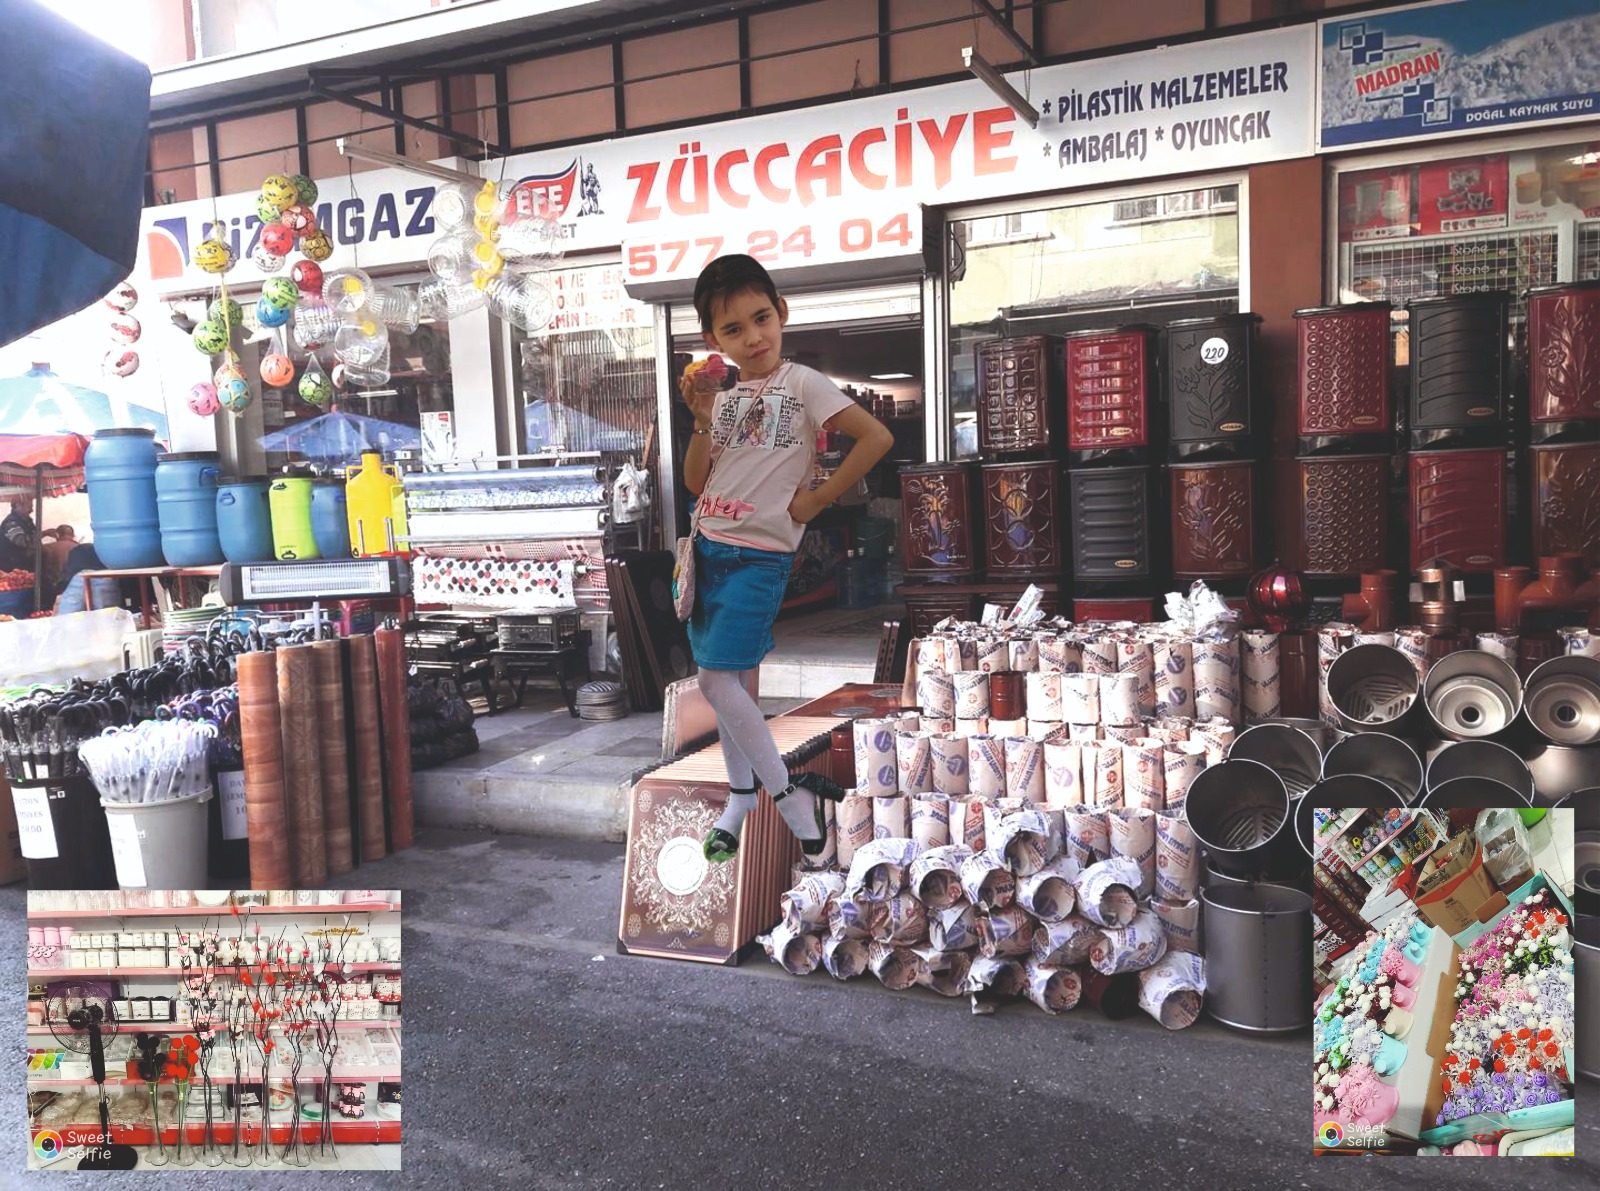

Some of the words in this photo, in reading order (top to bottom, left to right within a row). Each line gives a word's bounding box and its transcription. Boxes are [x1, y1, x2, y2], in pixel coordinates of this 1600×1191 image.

[1058, 80, 1144, 123] PİLASTİK
[1150, 61, 1289, 109] MALZEMELER
[1355, 52, 1440, 96] MADRAN
[1466, 110, 1505, 122] DOĞAL
[1509, 102, 1558, 117] KAYNAK
[1562, 99, 1593, 111] SUYU
[626, 106, 1019, 223] ZÜCCACİYE
[1058, 128, 1148, 168] AMBALAJ
[1171, 111, 1271, 151] OYUNCAK
[515, 184, 565, 217] EFE
[628, 236, 724, 276] 577
[747, 224, 816, 261] 24
[839, 212, 913, 252] 04
[1204, 347, 1225, 360] 220
